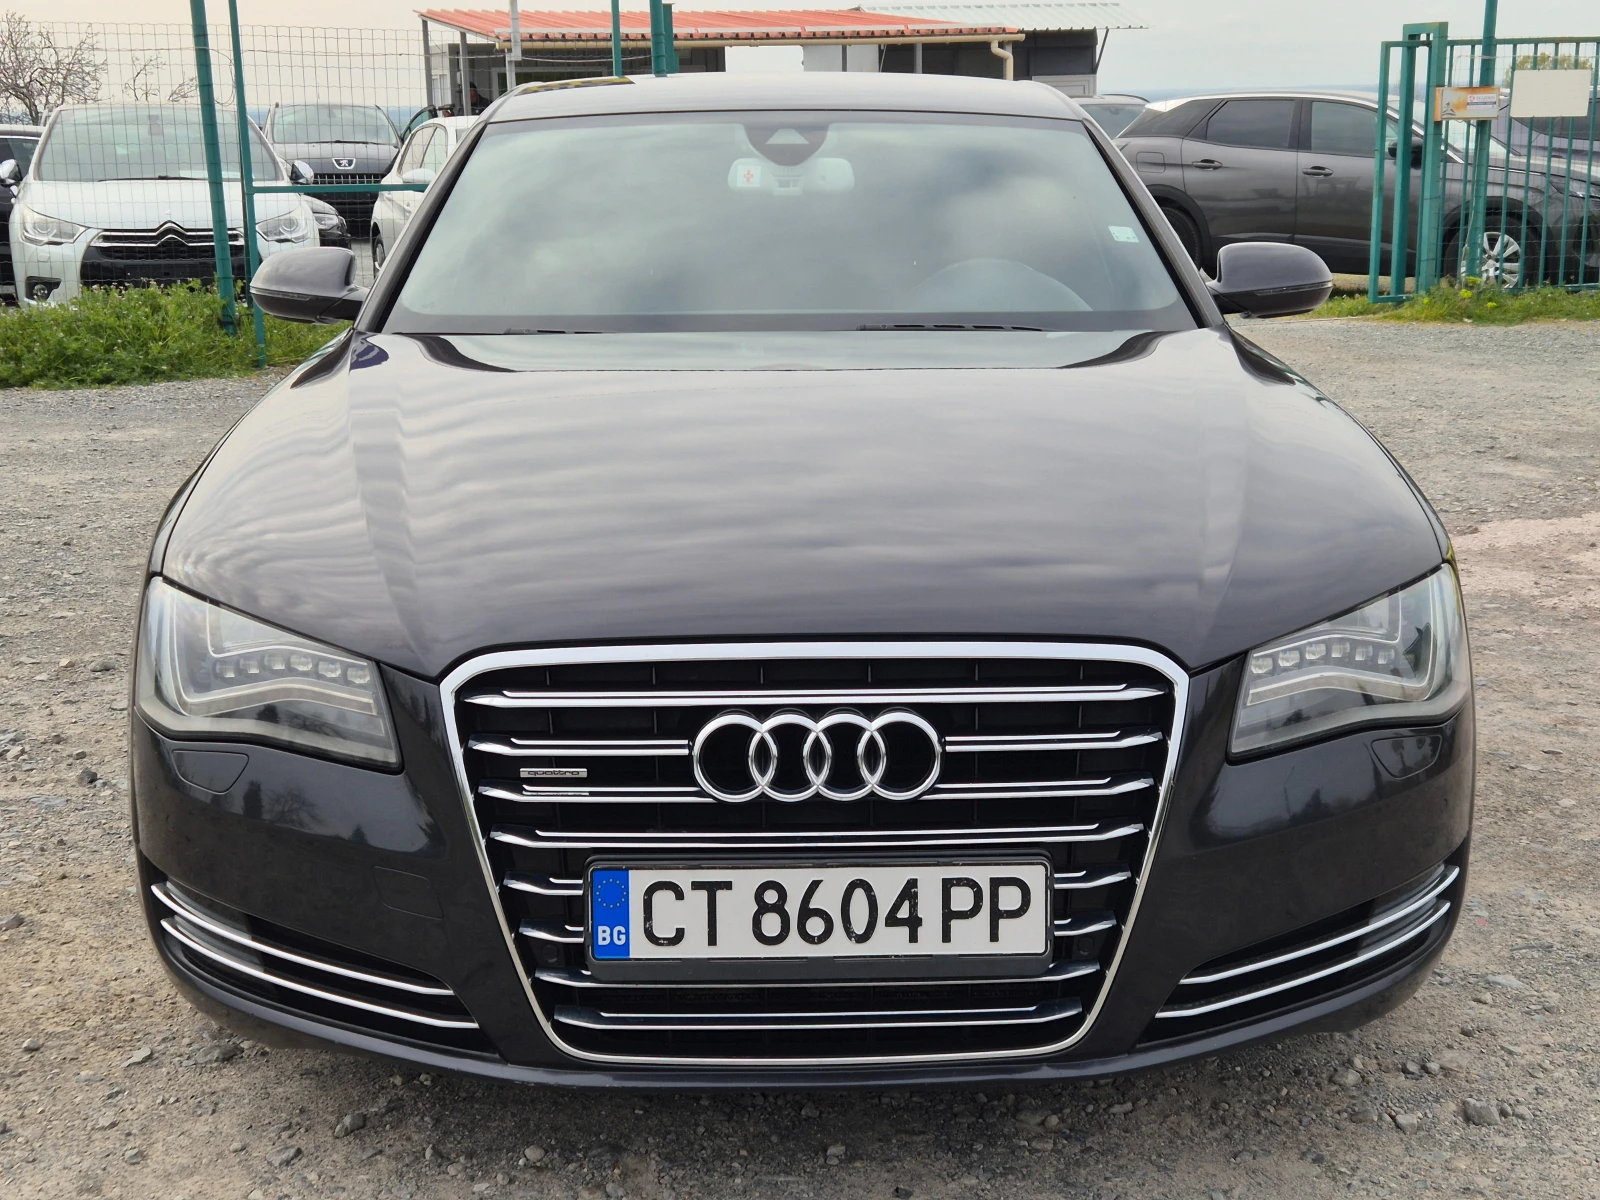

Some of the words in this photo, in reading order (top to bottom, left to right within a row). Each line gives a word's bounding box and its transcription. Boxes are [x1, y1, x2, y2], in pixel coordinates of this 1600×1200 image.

[527, 769, 580, 777] quattro
[642, 880, 733, 947] CT
[751, 878, 923, 946] 8604
[941, 876, 1032, 944] PP
[597, 925, 626, 946] BG
